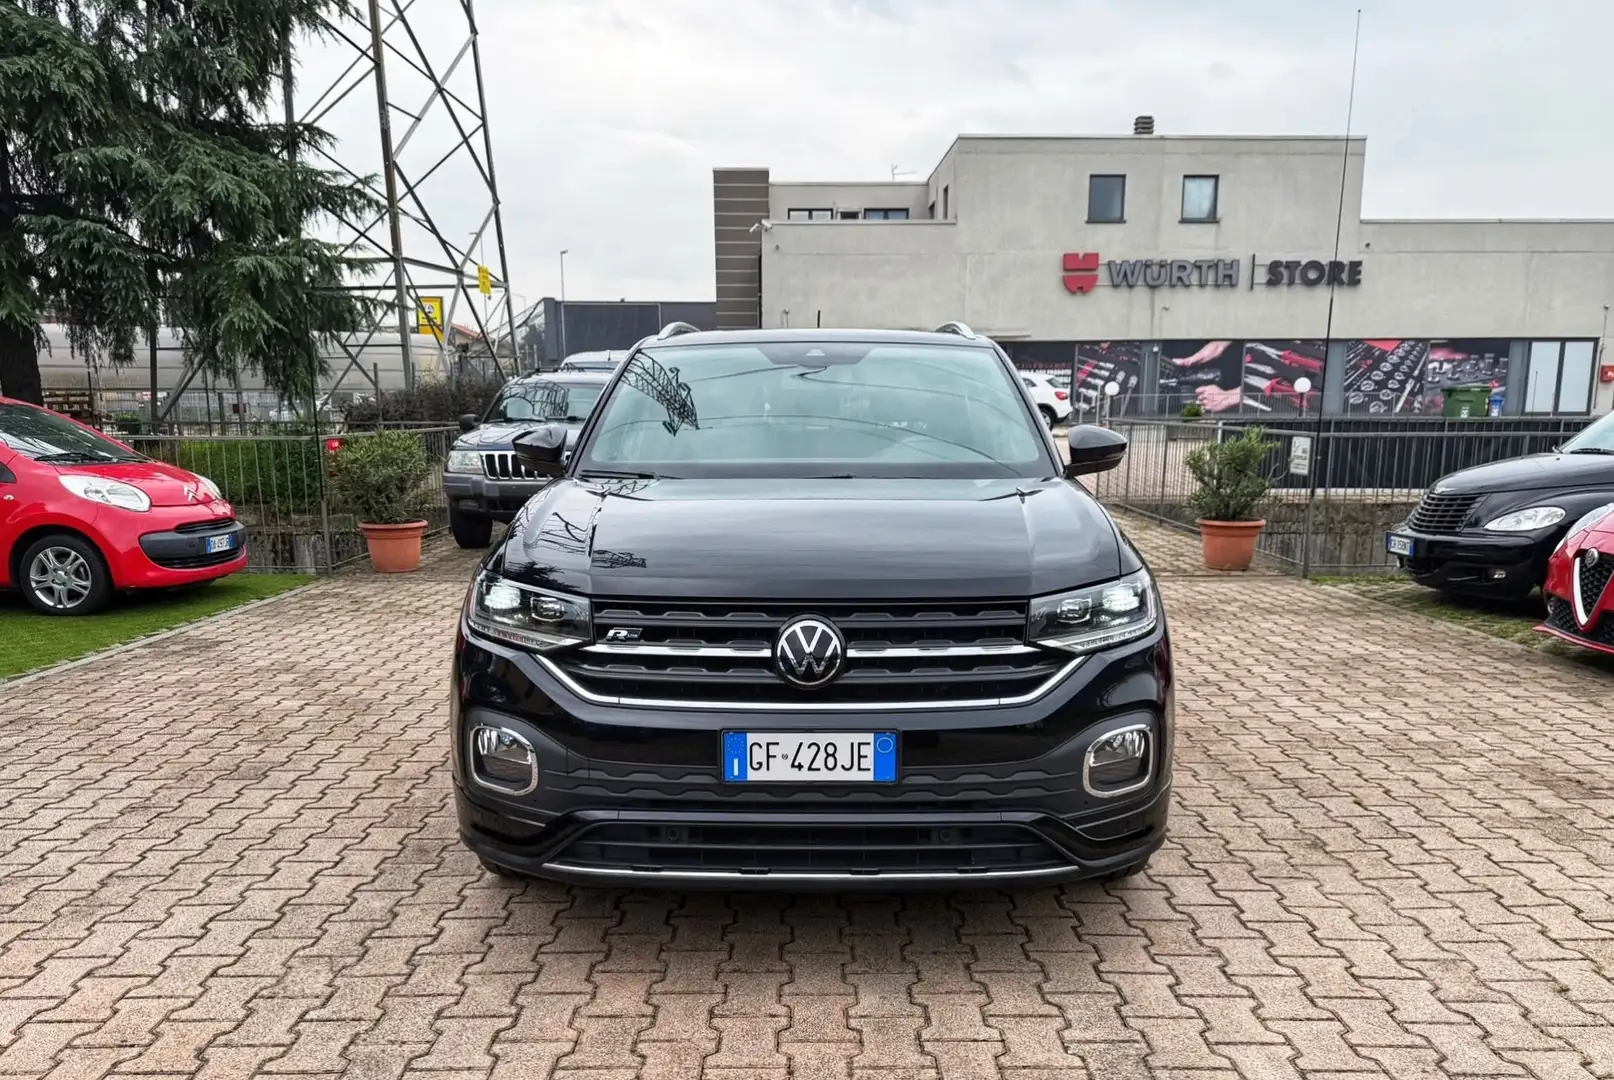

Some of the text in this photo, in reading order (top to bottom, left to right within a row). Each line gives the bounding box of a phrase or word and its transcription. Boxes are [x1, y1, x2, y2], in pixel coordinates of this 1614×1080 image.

[1108, 259, 1363, 288] WÜRTH STORE
[749, 741, 872, 772] GF 428JE
